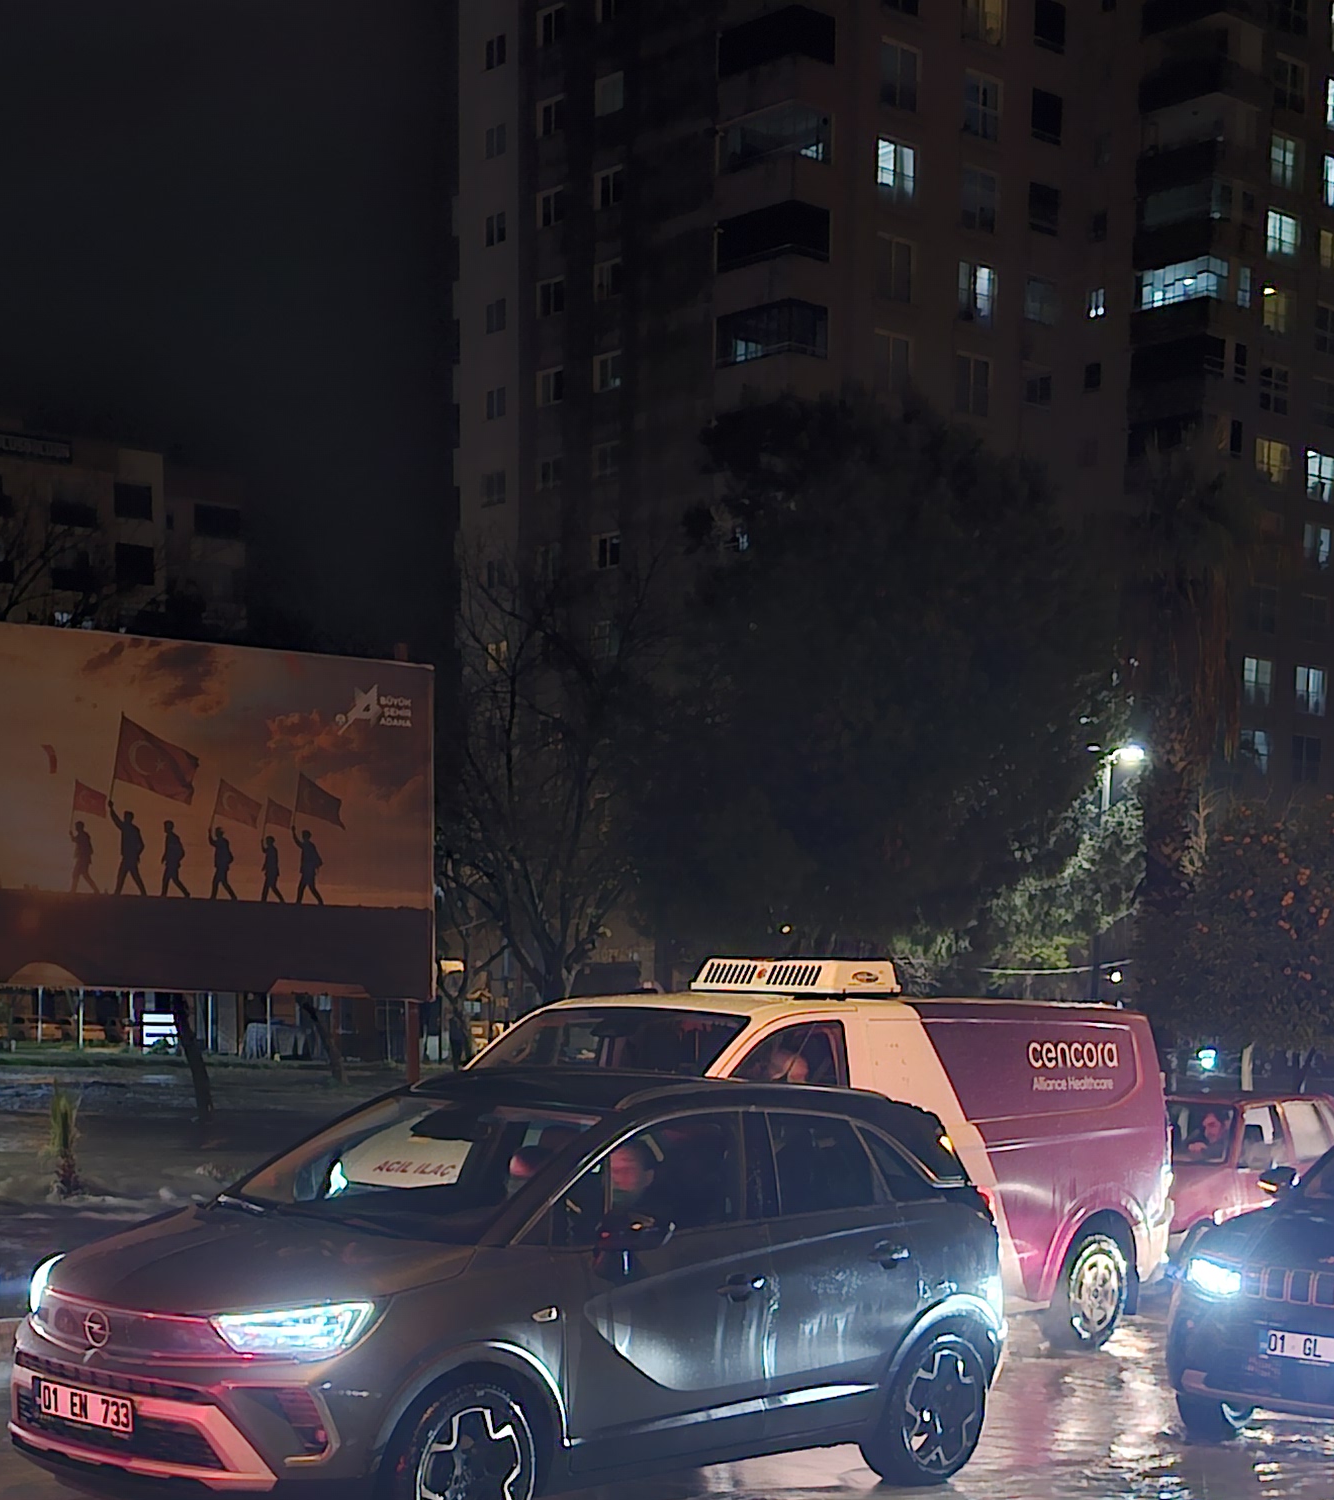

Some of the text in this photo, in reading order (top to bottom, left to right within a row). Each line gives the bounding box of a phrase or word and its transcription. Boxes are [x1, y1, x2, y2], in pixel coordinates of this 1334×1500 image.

[1028, 1041, 1119, 1069] cencora
[1033, 1075, 1114, 1092] Alliance Healthcare
[1268, 1333, 1285, 1353] 01
[1303, 1338, 1321, 1358] GL
[43, 1385, 129, 1428] 01 EN 733
